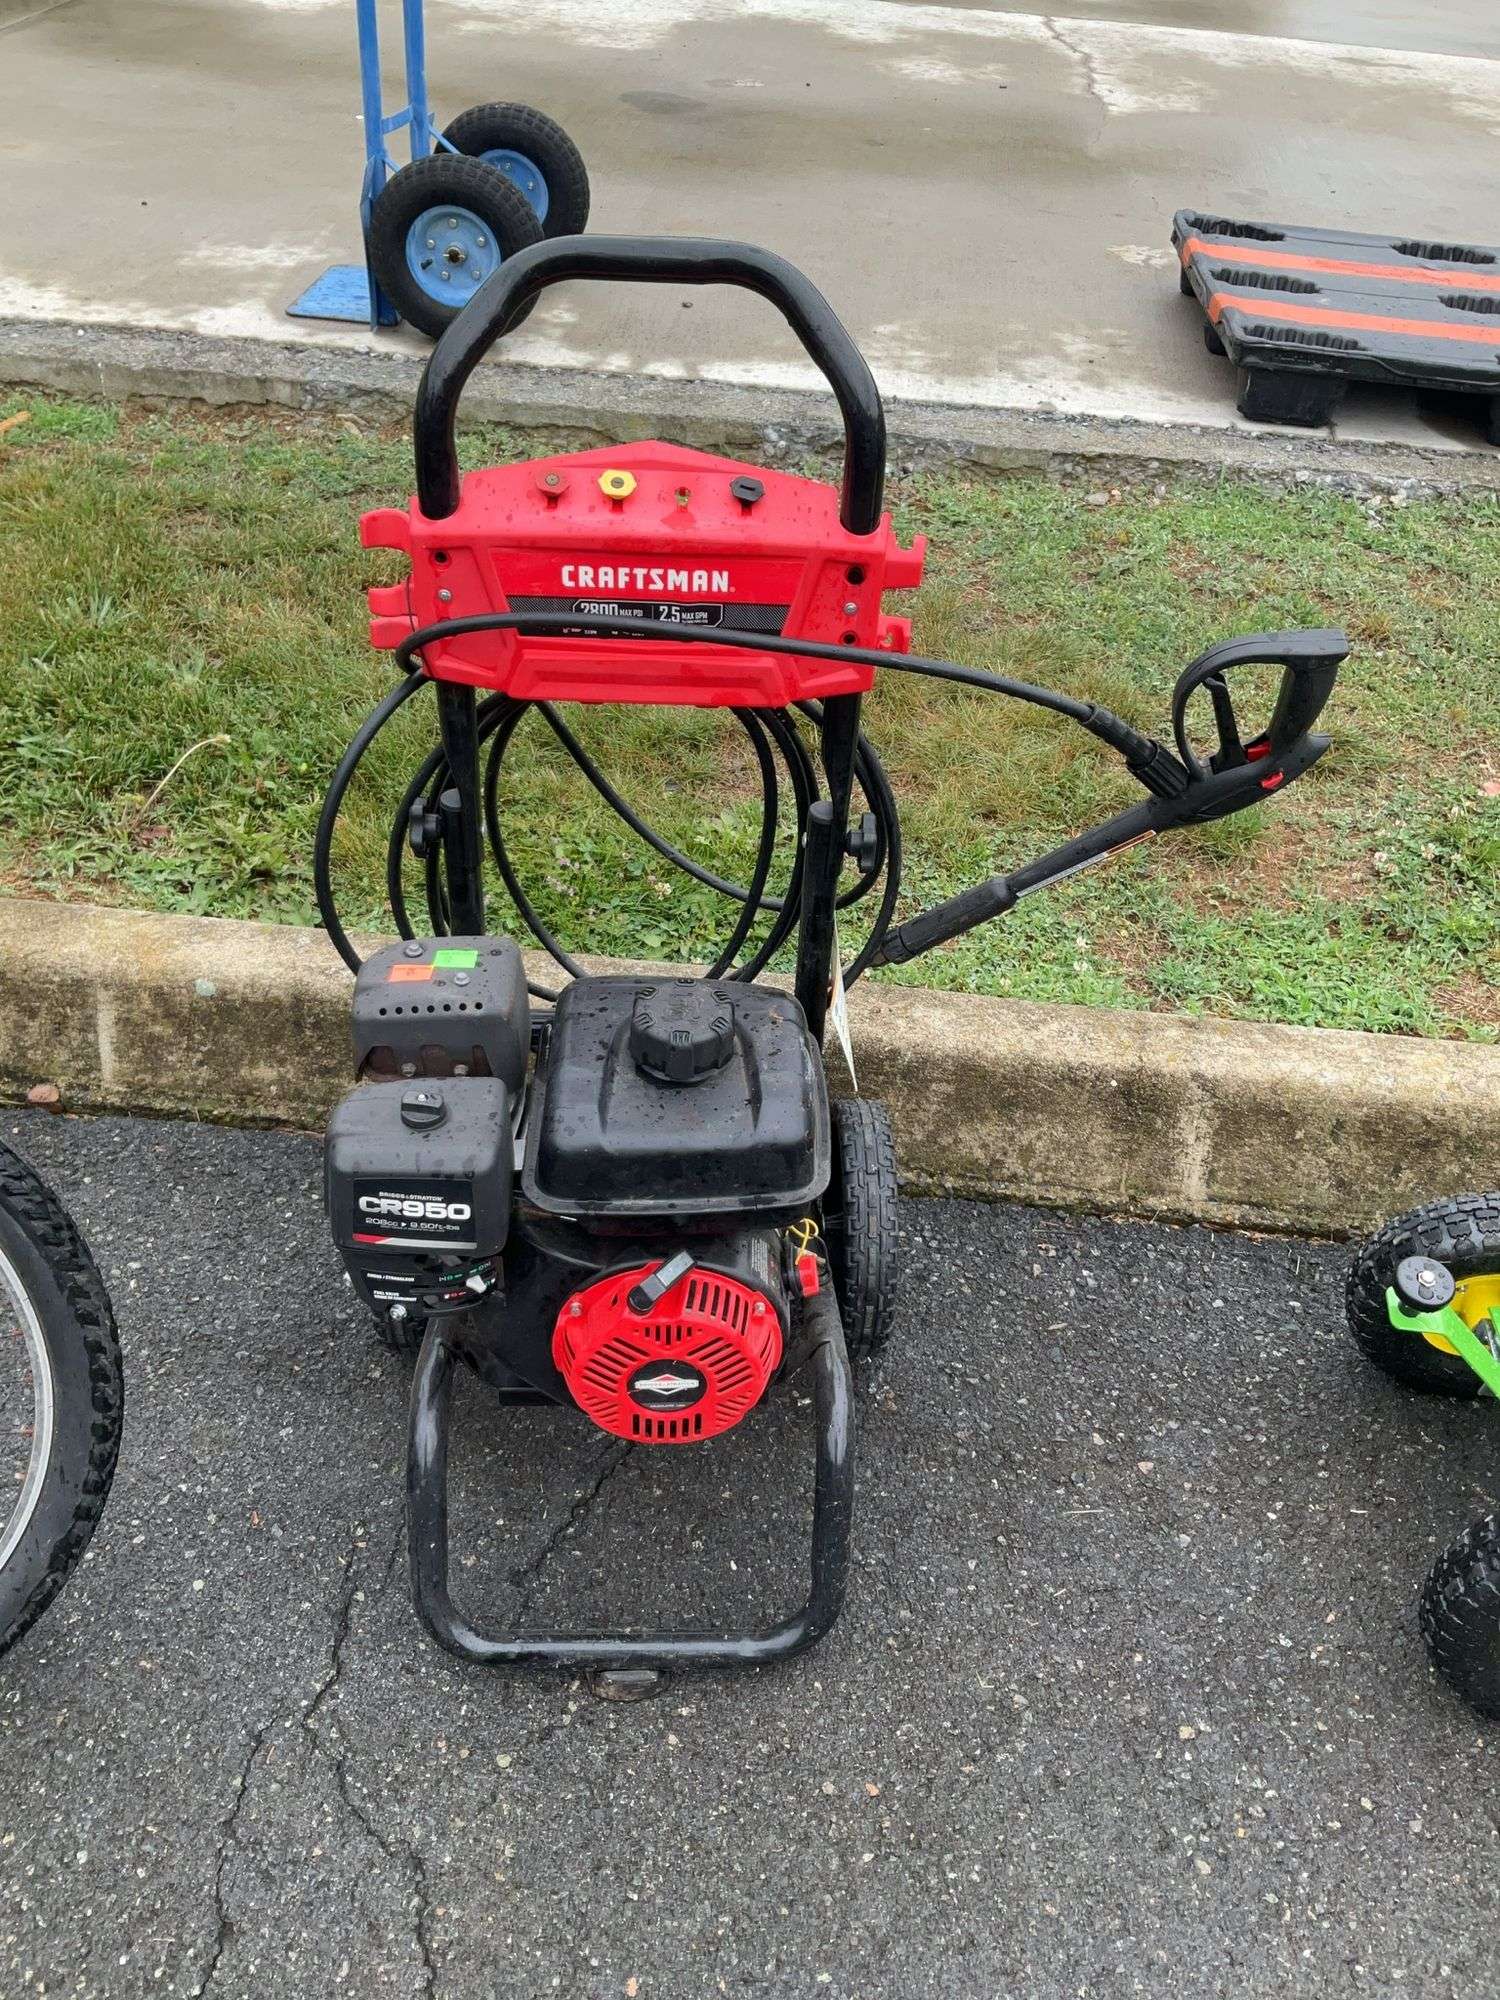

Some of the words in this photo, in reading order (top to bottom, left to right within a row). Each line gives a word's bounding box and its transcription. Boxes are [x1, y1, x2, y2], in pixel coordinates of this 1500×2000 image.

[561, 565, 729, 592] CRAFTSMAN
[620, 609, 632, 617] MAX
[633, 609, 644, 617] PSI
[659, 605, 680, 623] 2.5
[681, 611, 695, 620] MAX
[359, 1196, 471, 1220] CR950
